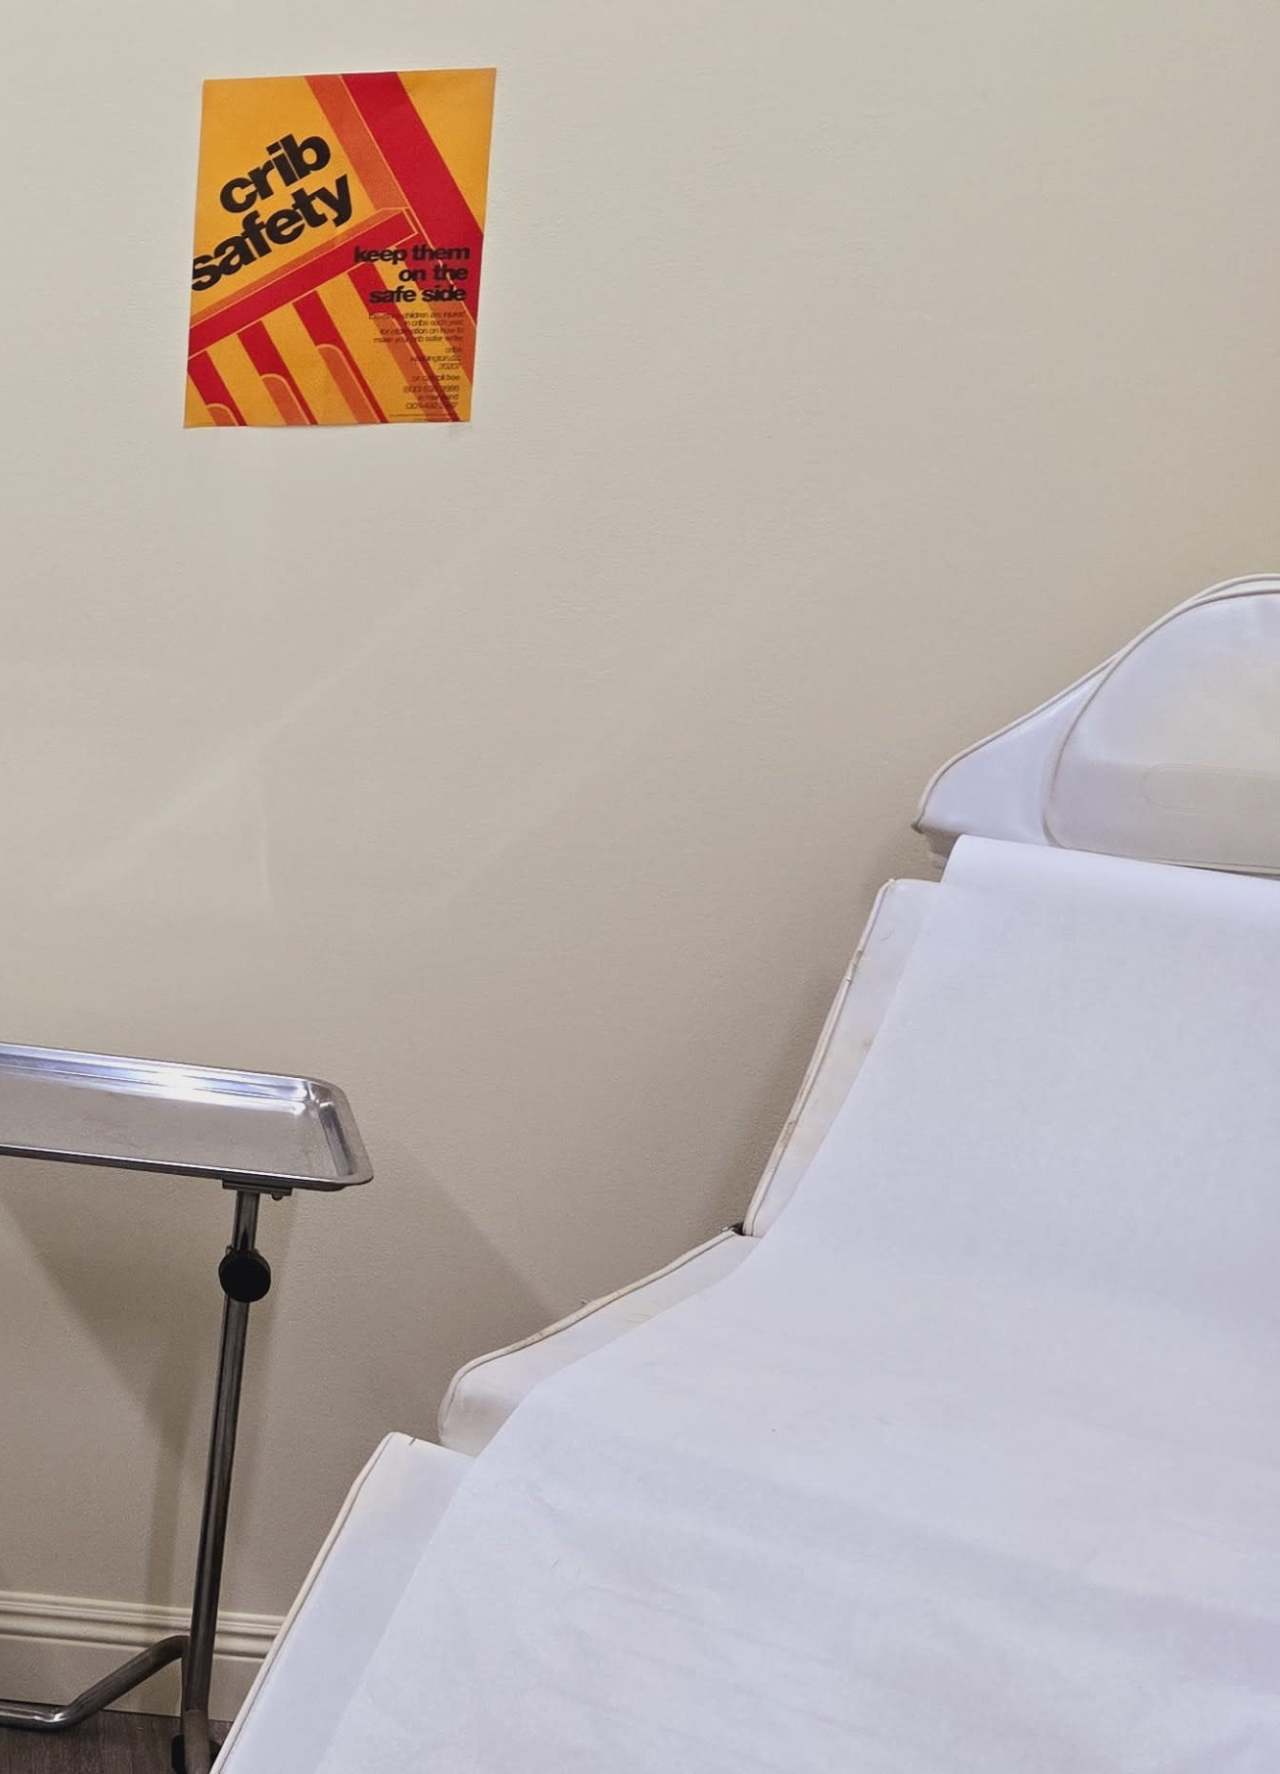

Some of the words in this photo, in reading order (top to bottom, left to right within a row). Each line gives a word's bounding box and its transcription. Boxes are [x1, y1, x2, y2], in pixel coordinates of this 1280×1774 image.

[219, 133, 331, 213] crib
[191, 174, 353, 291] safety
[354, 245, 407, 265] keep
[412, 244, 470, 261] them
[398, 268, 426, 282] on
[433, 263, 469, 280] the
[368, 285, 417, 303] safe
[421, 285, 466, 302] side
